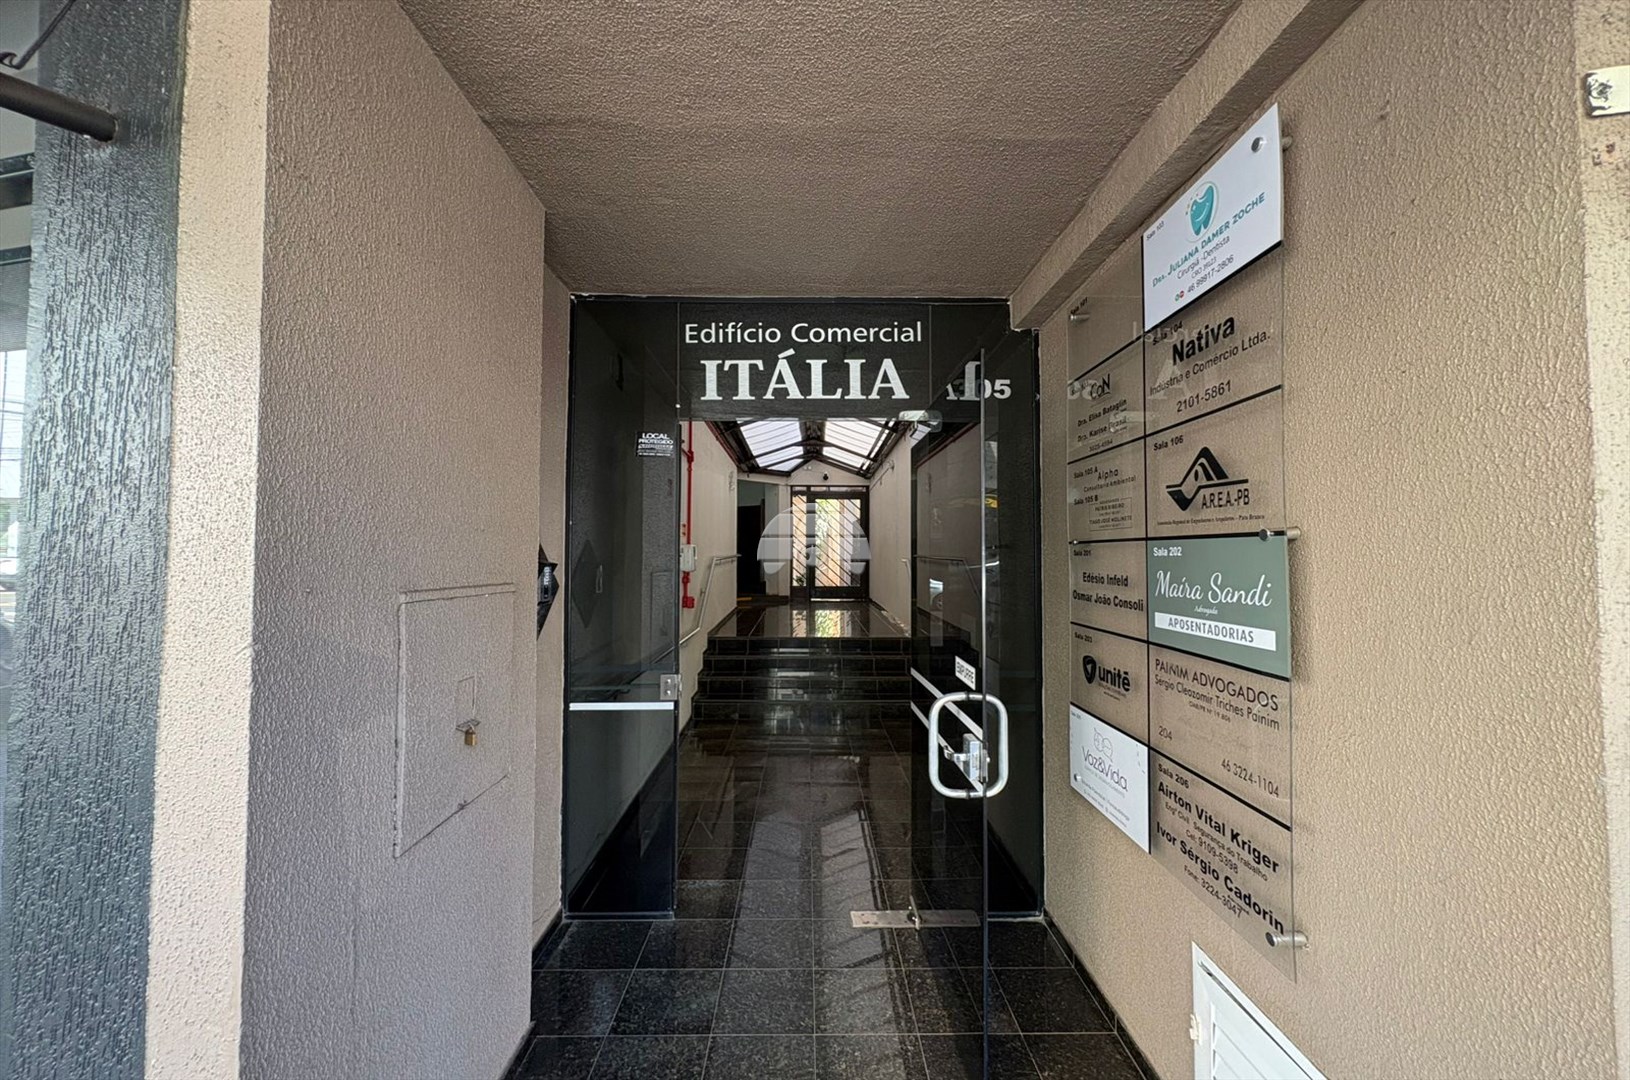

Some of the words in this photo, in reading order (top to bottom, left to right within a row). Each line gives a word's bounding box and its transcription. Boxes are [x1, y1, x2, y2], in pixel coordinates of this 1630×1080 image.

[1201, 220, 1230, 249] DAMER
[1232, 192, 1265, 225] ZOCHE
[685, 321, 781, 344] Edifício
[791, 321, 922, 343] Comercial
[1170, 321, 1183, 335] 104
[1172, 316, 1235, 366] Nativa
[1185, 370, 1191, 379] e
[1192, 345, 1239, 375] Comércio
[1241, 331, 1270, 352] Ltda.
[700, 348, 910, 400] ITÁLIA
[1176, 379, 1231, 413] 2101-5861
[1153, 441, 1168, 451] Sala
[1171, 435, 1184, 446] 106
[1153, 547, 1168, 557] Sala
[1169, 546, 1183, 557] 202
[1082, 572, 1105, 585] Edésio
[1106, 574, 1129, 587] Infeld
[1155, 570, 1204, 600] Maíra
[1208, 572, 1272, 607] Sandi
[1073, 589, 1093, 603] Osmar
[1094, 593, 1112, 606] João
[1113, 595, 1144, 612] Consoli
[1168, 617, 1254, 643] APOSENTADORIAS
[1154, 674, 1174, 691] Sergio
[1216, 695, 1244, 718] Triches
[1247, 706, 1280, 731] Painim
[1155, 658, 1189, 681] PAINIM
[1191, 671, 1279, 712] ADVOGADOS
[1159, 725, 1173, 740] 204
[1158, 763, 1174, 779] Sala
[1175, 774, 1190, 789] 206
[1221, 758, 1231, 773] 46
[1232, 763, 1280, 799] 3224-1104
[1158, 781, 1192, 813] Airton
[1195, 804, 1226, 837] Vital
[1230, 828, 1280, 873] Kriger
[1198, 836, 1239, 874] 9109-5398
[1226, 847, 1236, 858] do
[1236, 852, 1269, 882] Trabalho
[1157, 821, 1178, 846] Ivor
[1180, 840, 1220, 881] Sérgio
[1224, 875, 1285, 935] Cadorin
[1201, 877, 1243, 918] 3224-3047
